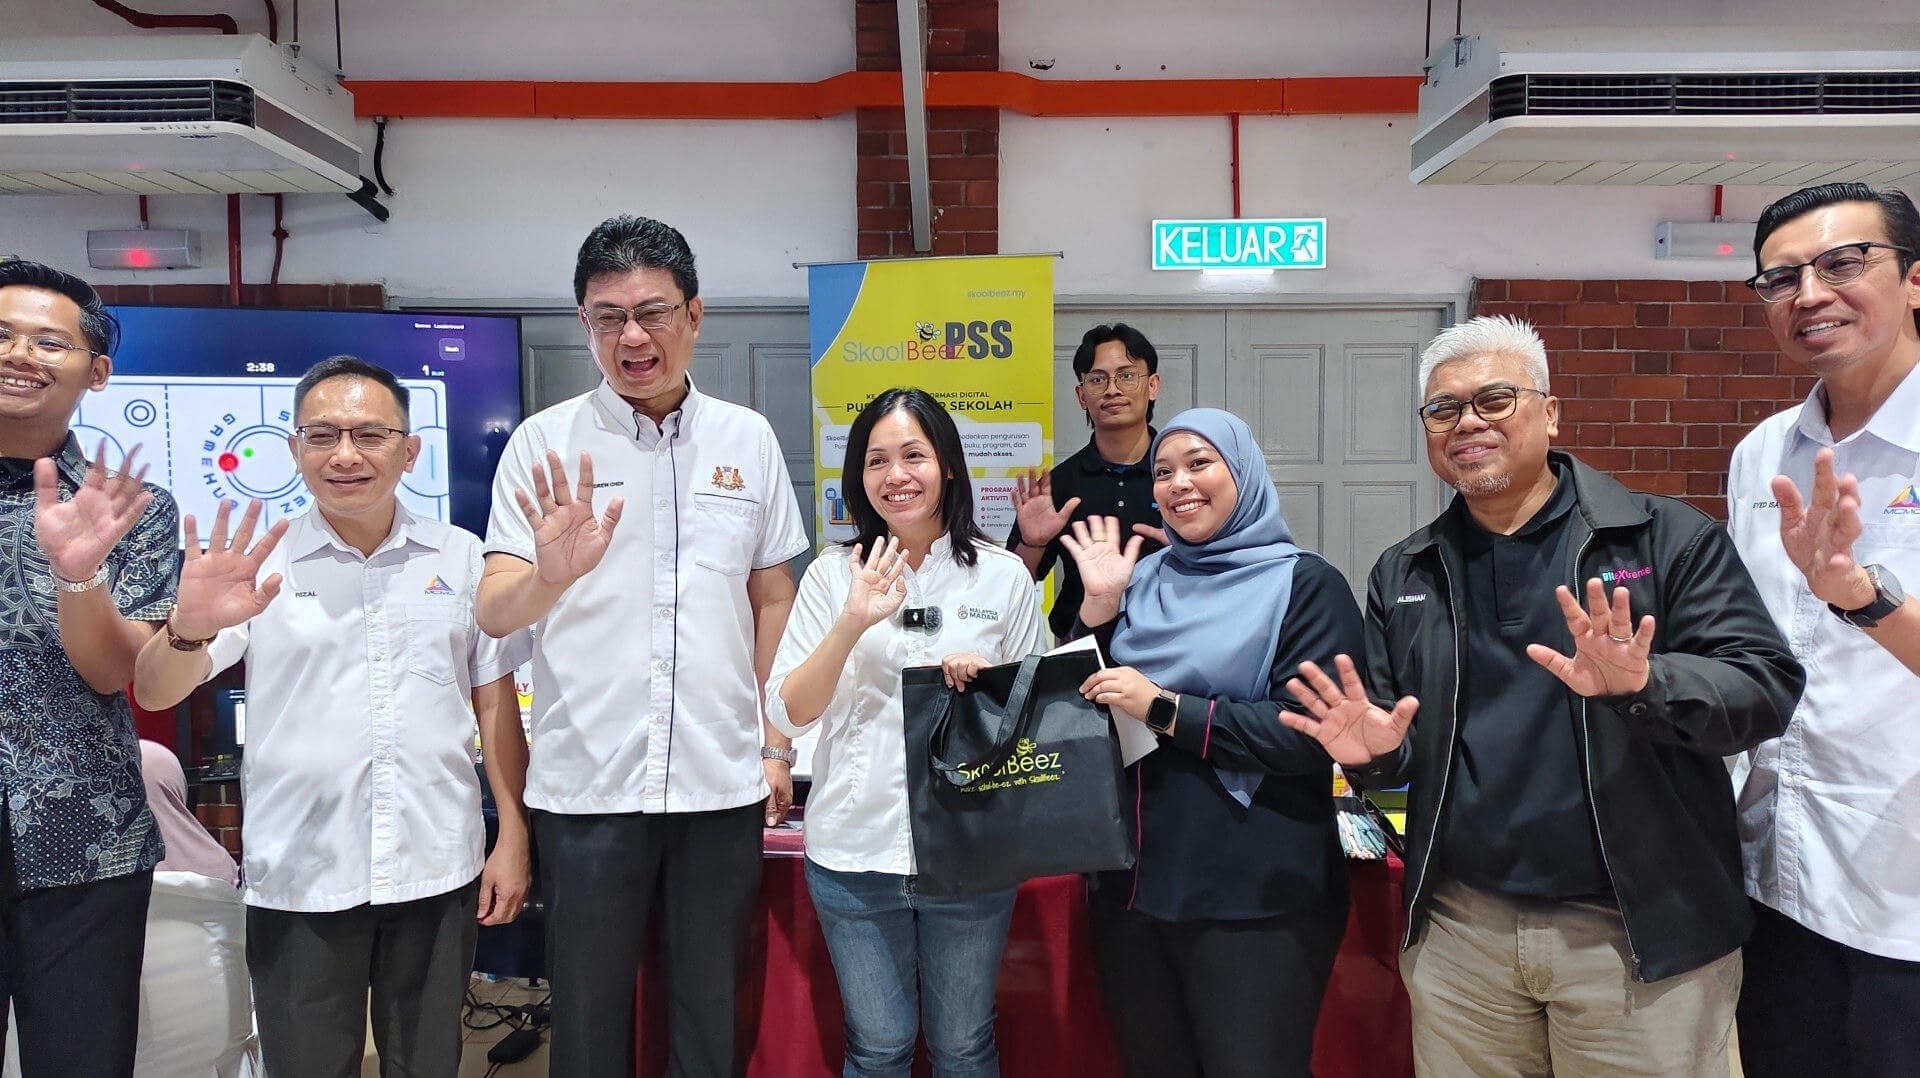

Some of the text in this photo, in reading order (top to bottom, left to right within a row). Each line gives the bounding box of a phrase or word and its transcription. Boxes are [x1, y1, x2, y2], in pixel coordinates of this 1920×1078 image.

[1159, 225, 1287, 264] KELUAR
[945, 319, 1013, 360] PSS
[246, 362, 275, 373] 2:38
[950, 400, 1013, 411] SEKOLAH
[295, 590, 318, 598] RIZAL
[969, 613, 999, 621] MADANI
